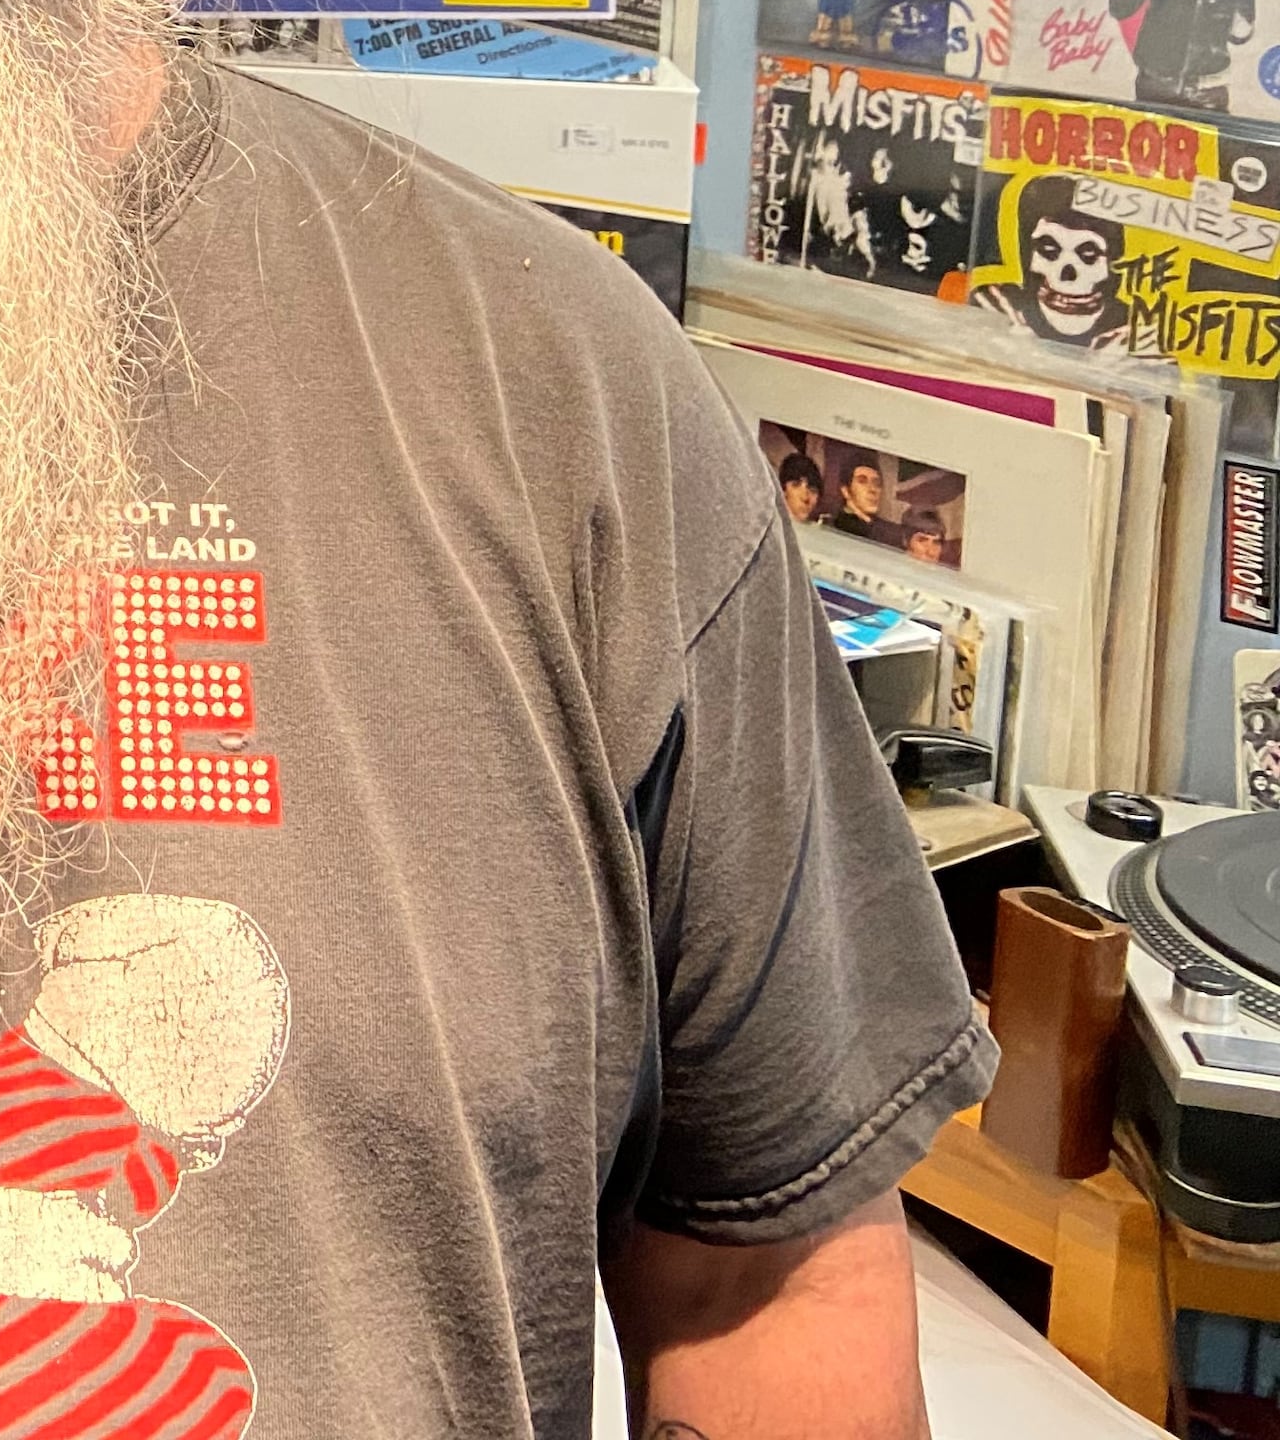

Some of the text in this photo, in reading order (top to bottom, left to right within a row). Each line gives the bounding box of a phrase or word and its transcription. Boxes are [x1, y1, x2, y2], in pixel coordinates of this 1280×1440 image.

[353, 23, 423, 58] 7:00 PM
[416, 30, 497, 60] GENERAL
[1040, 6, 1108, 48] Baby
[476, 34, 559, 65] Directions:
[1047, 38, 1115, 73] Baby
[807, 66, 969, 143] MISFITS
[988, 107, 1200, 182] HORROR
[762, 103, 795, 265] HALLOWE
[1072, 179, 1278, 254] BUSINESS
[1112, 247, 1182, 293] THE
[1128, 292, 1280, 368] MISFITS
[833, 414, 891, 440] THE WHO
[190, 502, 236, 533] IT,
[146, 536, 257, 563] LAND
[1230, 470, 1271, 622] FLOWMASTER
